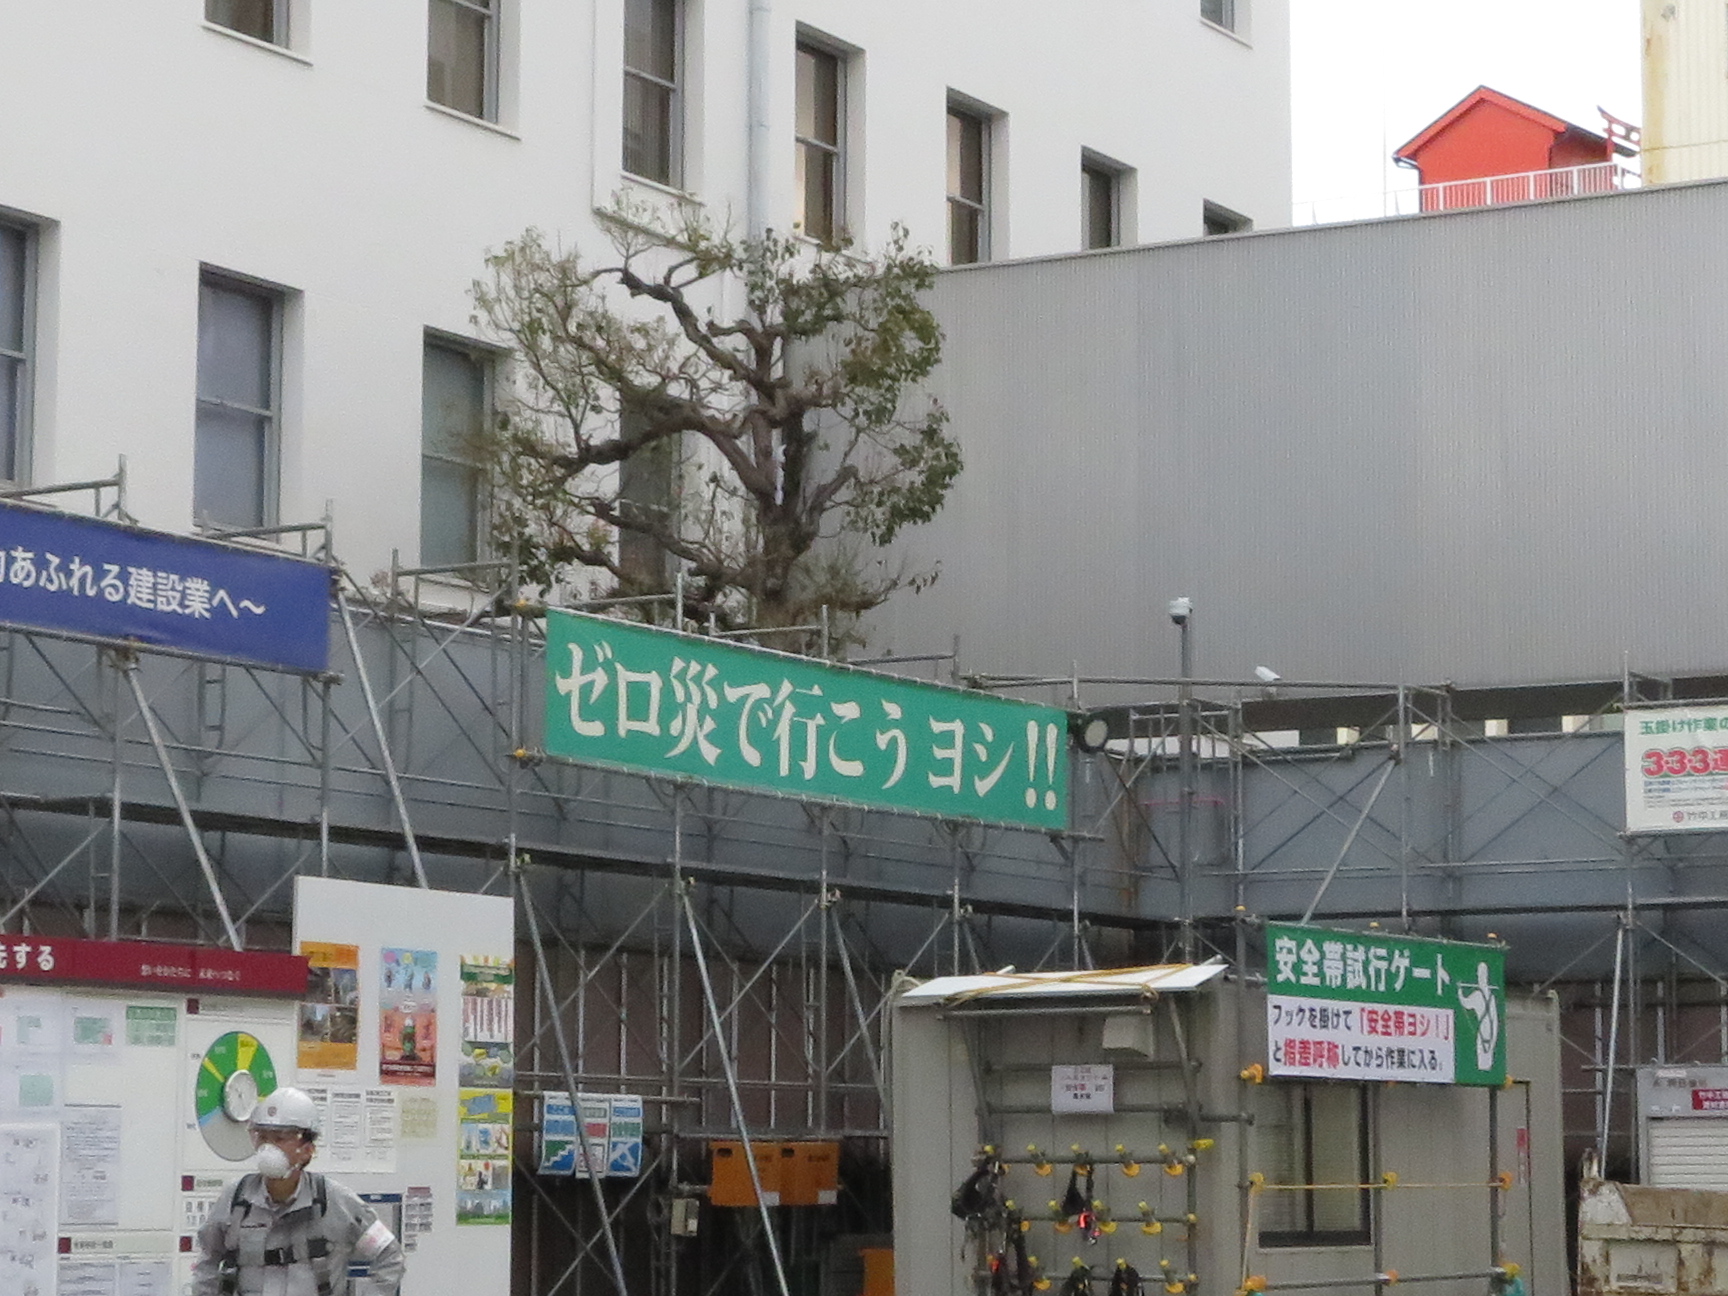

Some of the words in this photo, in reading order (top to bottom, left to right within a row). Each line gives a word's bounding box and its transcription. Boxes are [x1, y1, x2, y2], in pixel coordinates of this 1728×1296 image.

[1275, 935, 1450, 996] 安全帯試行ゲート
